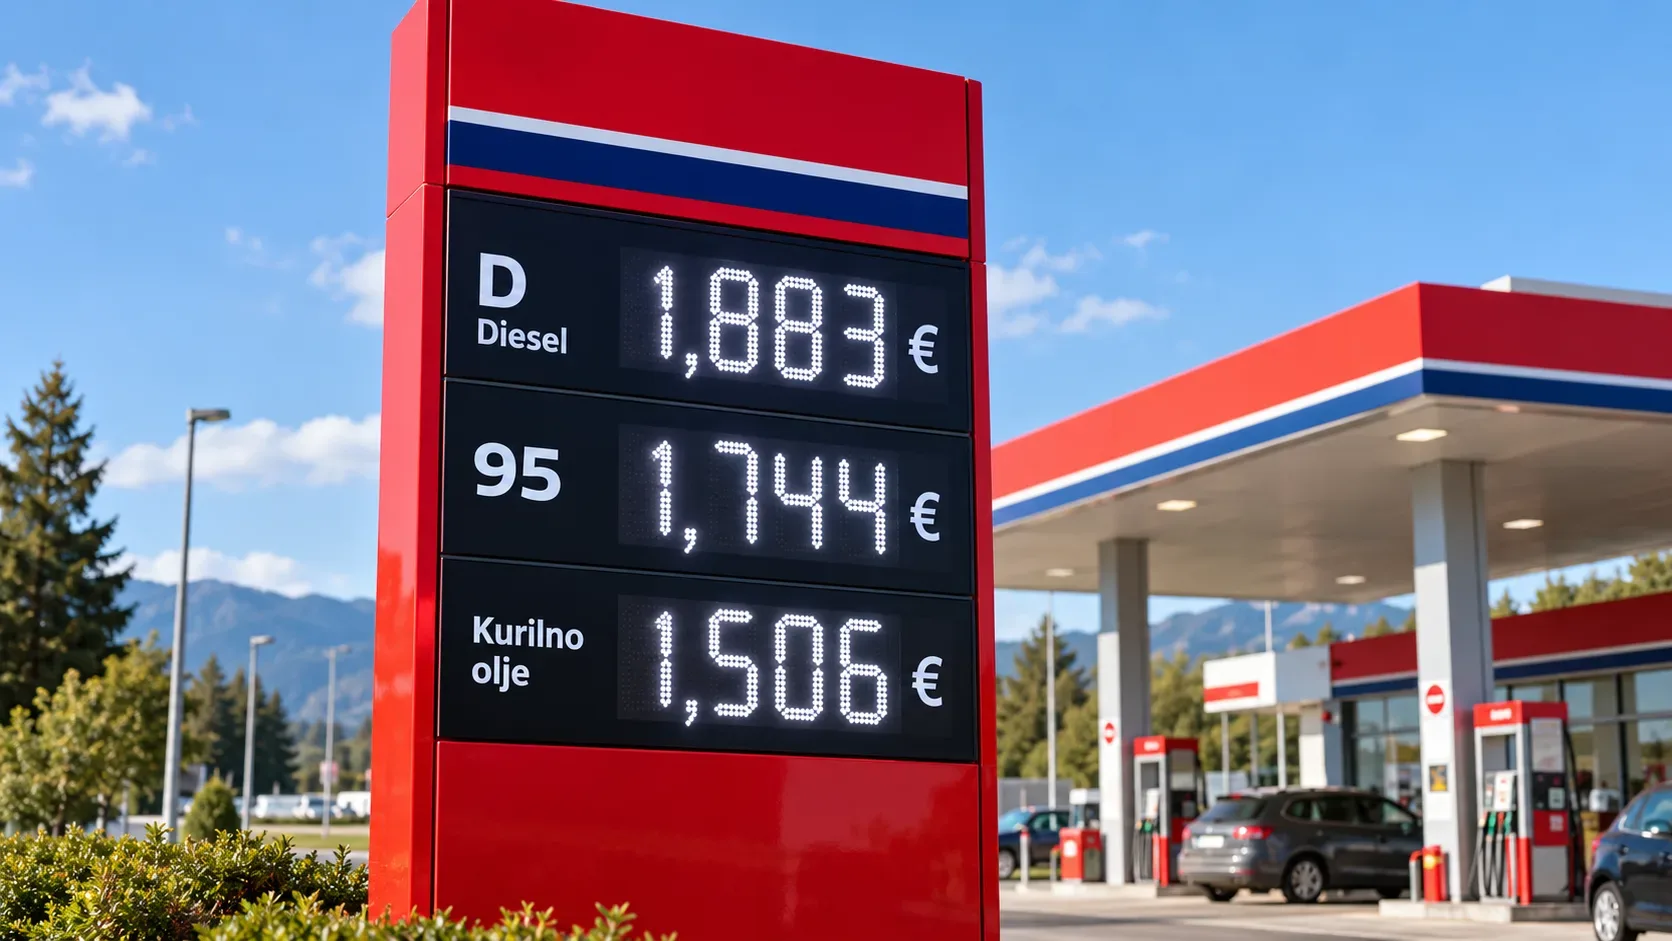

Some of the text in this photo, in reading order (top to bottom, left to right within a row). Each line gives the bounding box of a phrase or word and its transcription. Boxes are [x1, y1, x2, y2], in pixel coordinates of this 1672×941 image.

[479, 253, 526, 309] D
[478, 317, 567, 355] Diesel
[653, 265, 939, 389] 1,883 €
[474, 443, 561, 502] 95
[651, 439, 940, 556] 1,744 €
[473, 615, 584, 651] Kurilno
[472, 655, 530, 692] olje
[653, 609, 943, 726] 1,506 €
